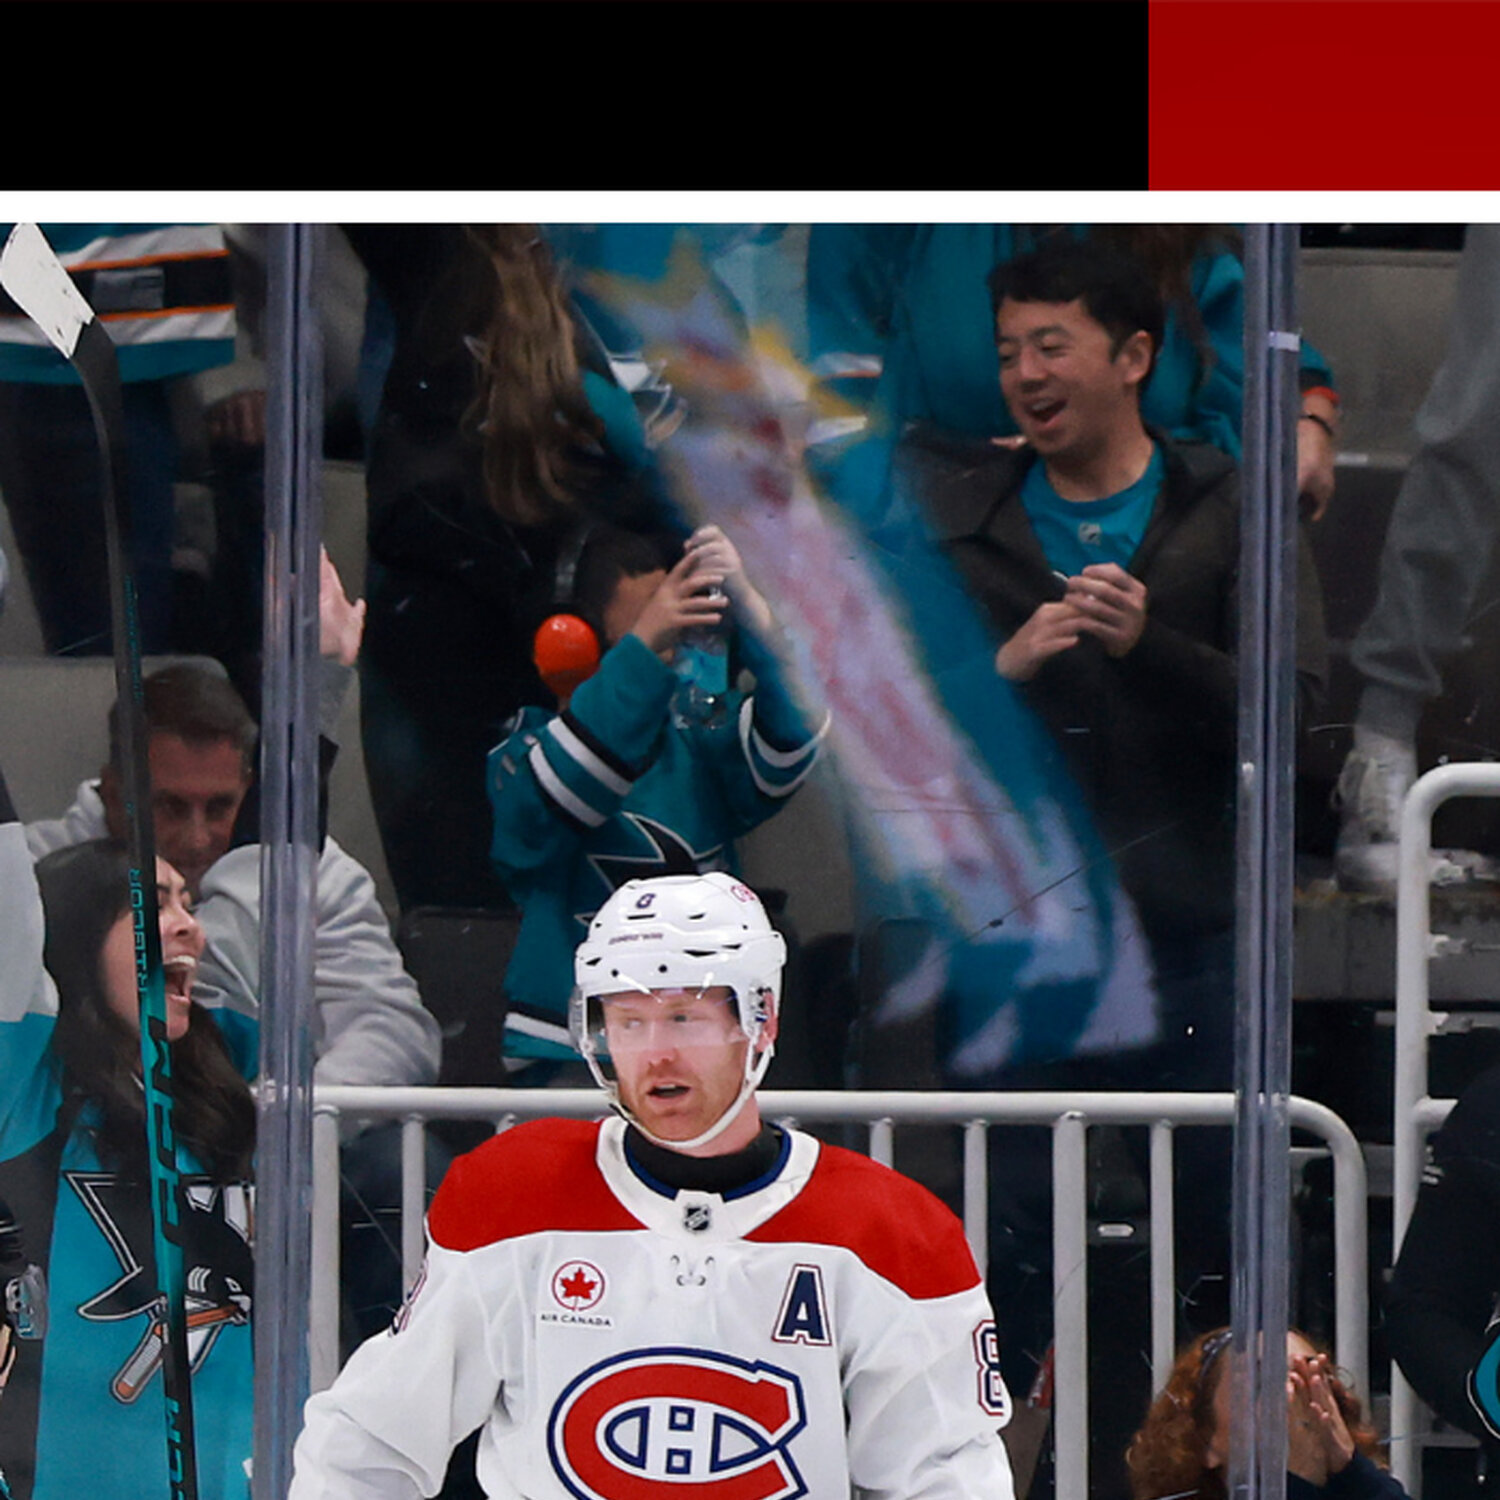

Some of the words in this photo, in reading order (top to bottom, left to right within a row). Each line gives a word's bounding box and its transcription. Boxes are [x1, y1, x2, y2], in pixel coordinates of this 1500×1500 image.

[540, 1313, 558, 1322] AIR
[561, 1314, 612, 1327] CANADA
[771, 1263, 833, 1347] A
